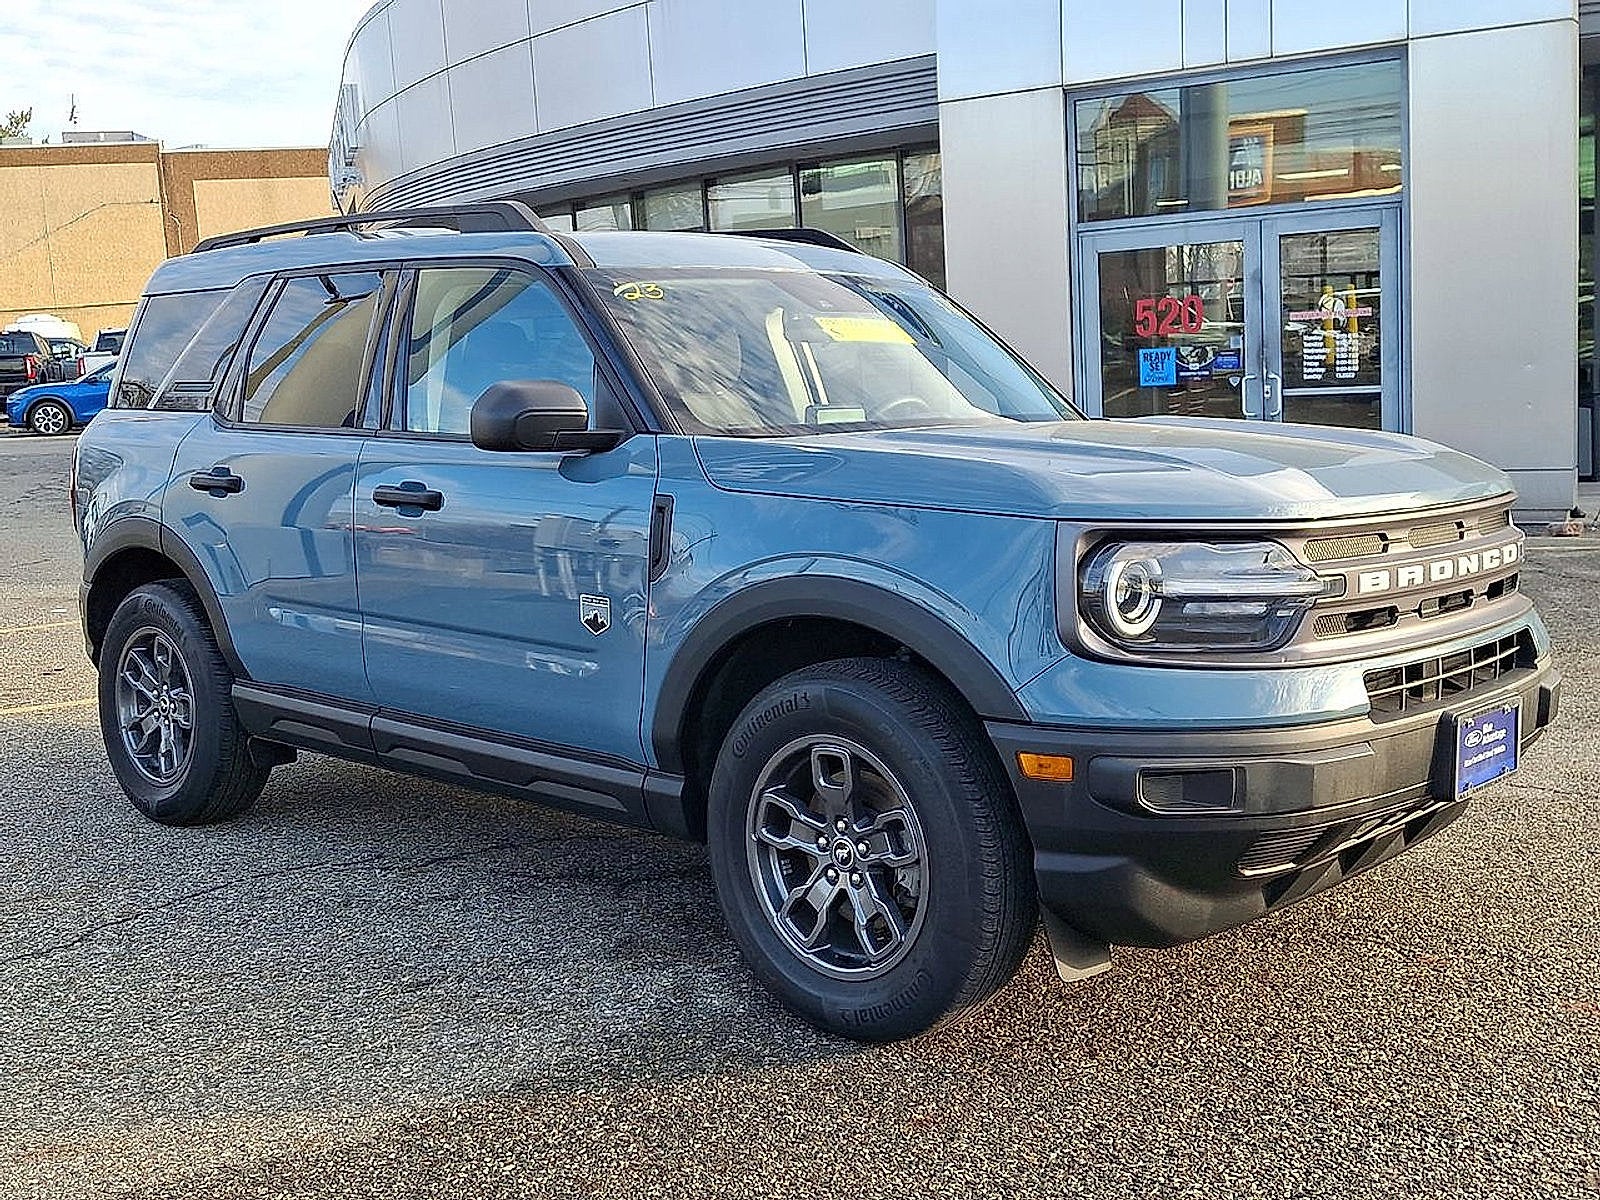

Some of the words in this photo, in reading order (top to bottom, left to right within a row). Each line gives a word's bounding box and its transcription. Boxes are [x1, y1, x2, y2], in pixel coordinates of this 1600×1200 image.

[1136, 294, 1203, 338] 520
[1143, 351, 1172, 362] READY
[1149, 361, 1166, 372] SET
[1358, 543, 1519, 594] BRONCO
[732, 691, 799, 759] Continental
